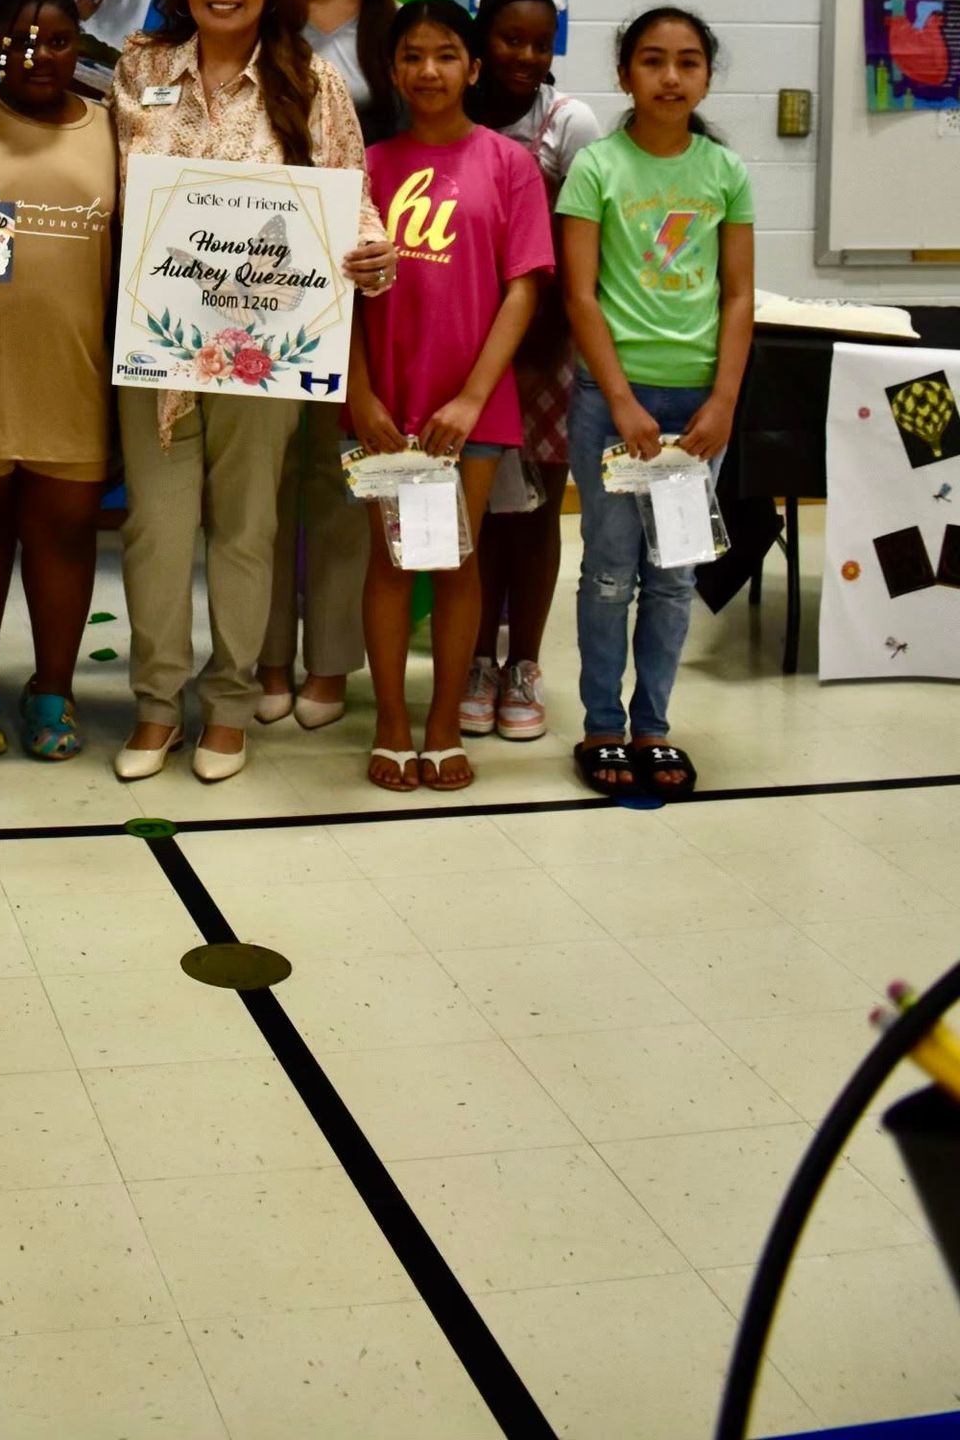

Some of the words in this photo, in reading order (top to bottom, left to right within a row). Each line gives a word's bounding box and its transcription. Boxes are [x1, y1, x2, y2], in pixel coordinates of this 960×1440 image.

[187, 192, 224, 206] Circle
[228, 196, 242, 208] of
[247, 196, 298, 212] Friends
[386, 167, 458, 251] hi
[189, 229, 291, 268] Honoring
[149, 256, 230, 290] Audrey
[235, 262, 331, 289] Quezada
[201, 290, 238, 308] Room
[242, 295, 279, 311] 1240
[116, 364, 168, 378] Platinum
